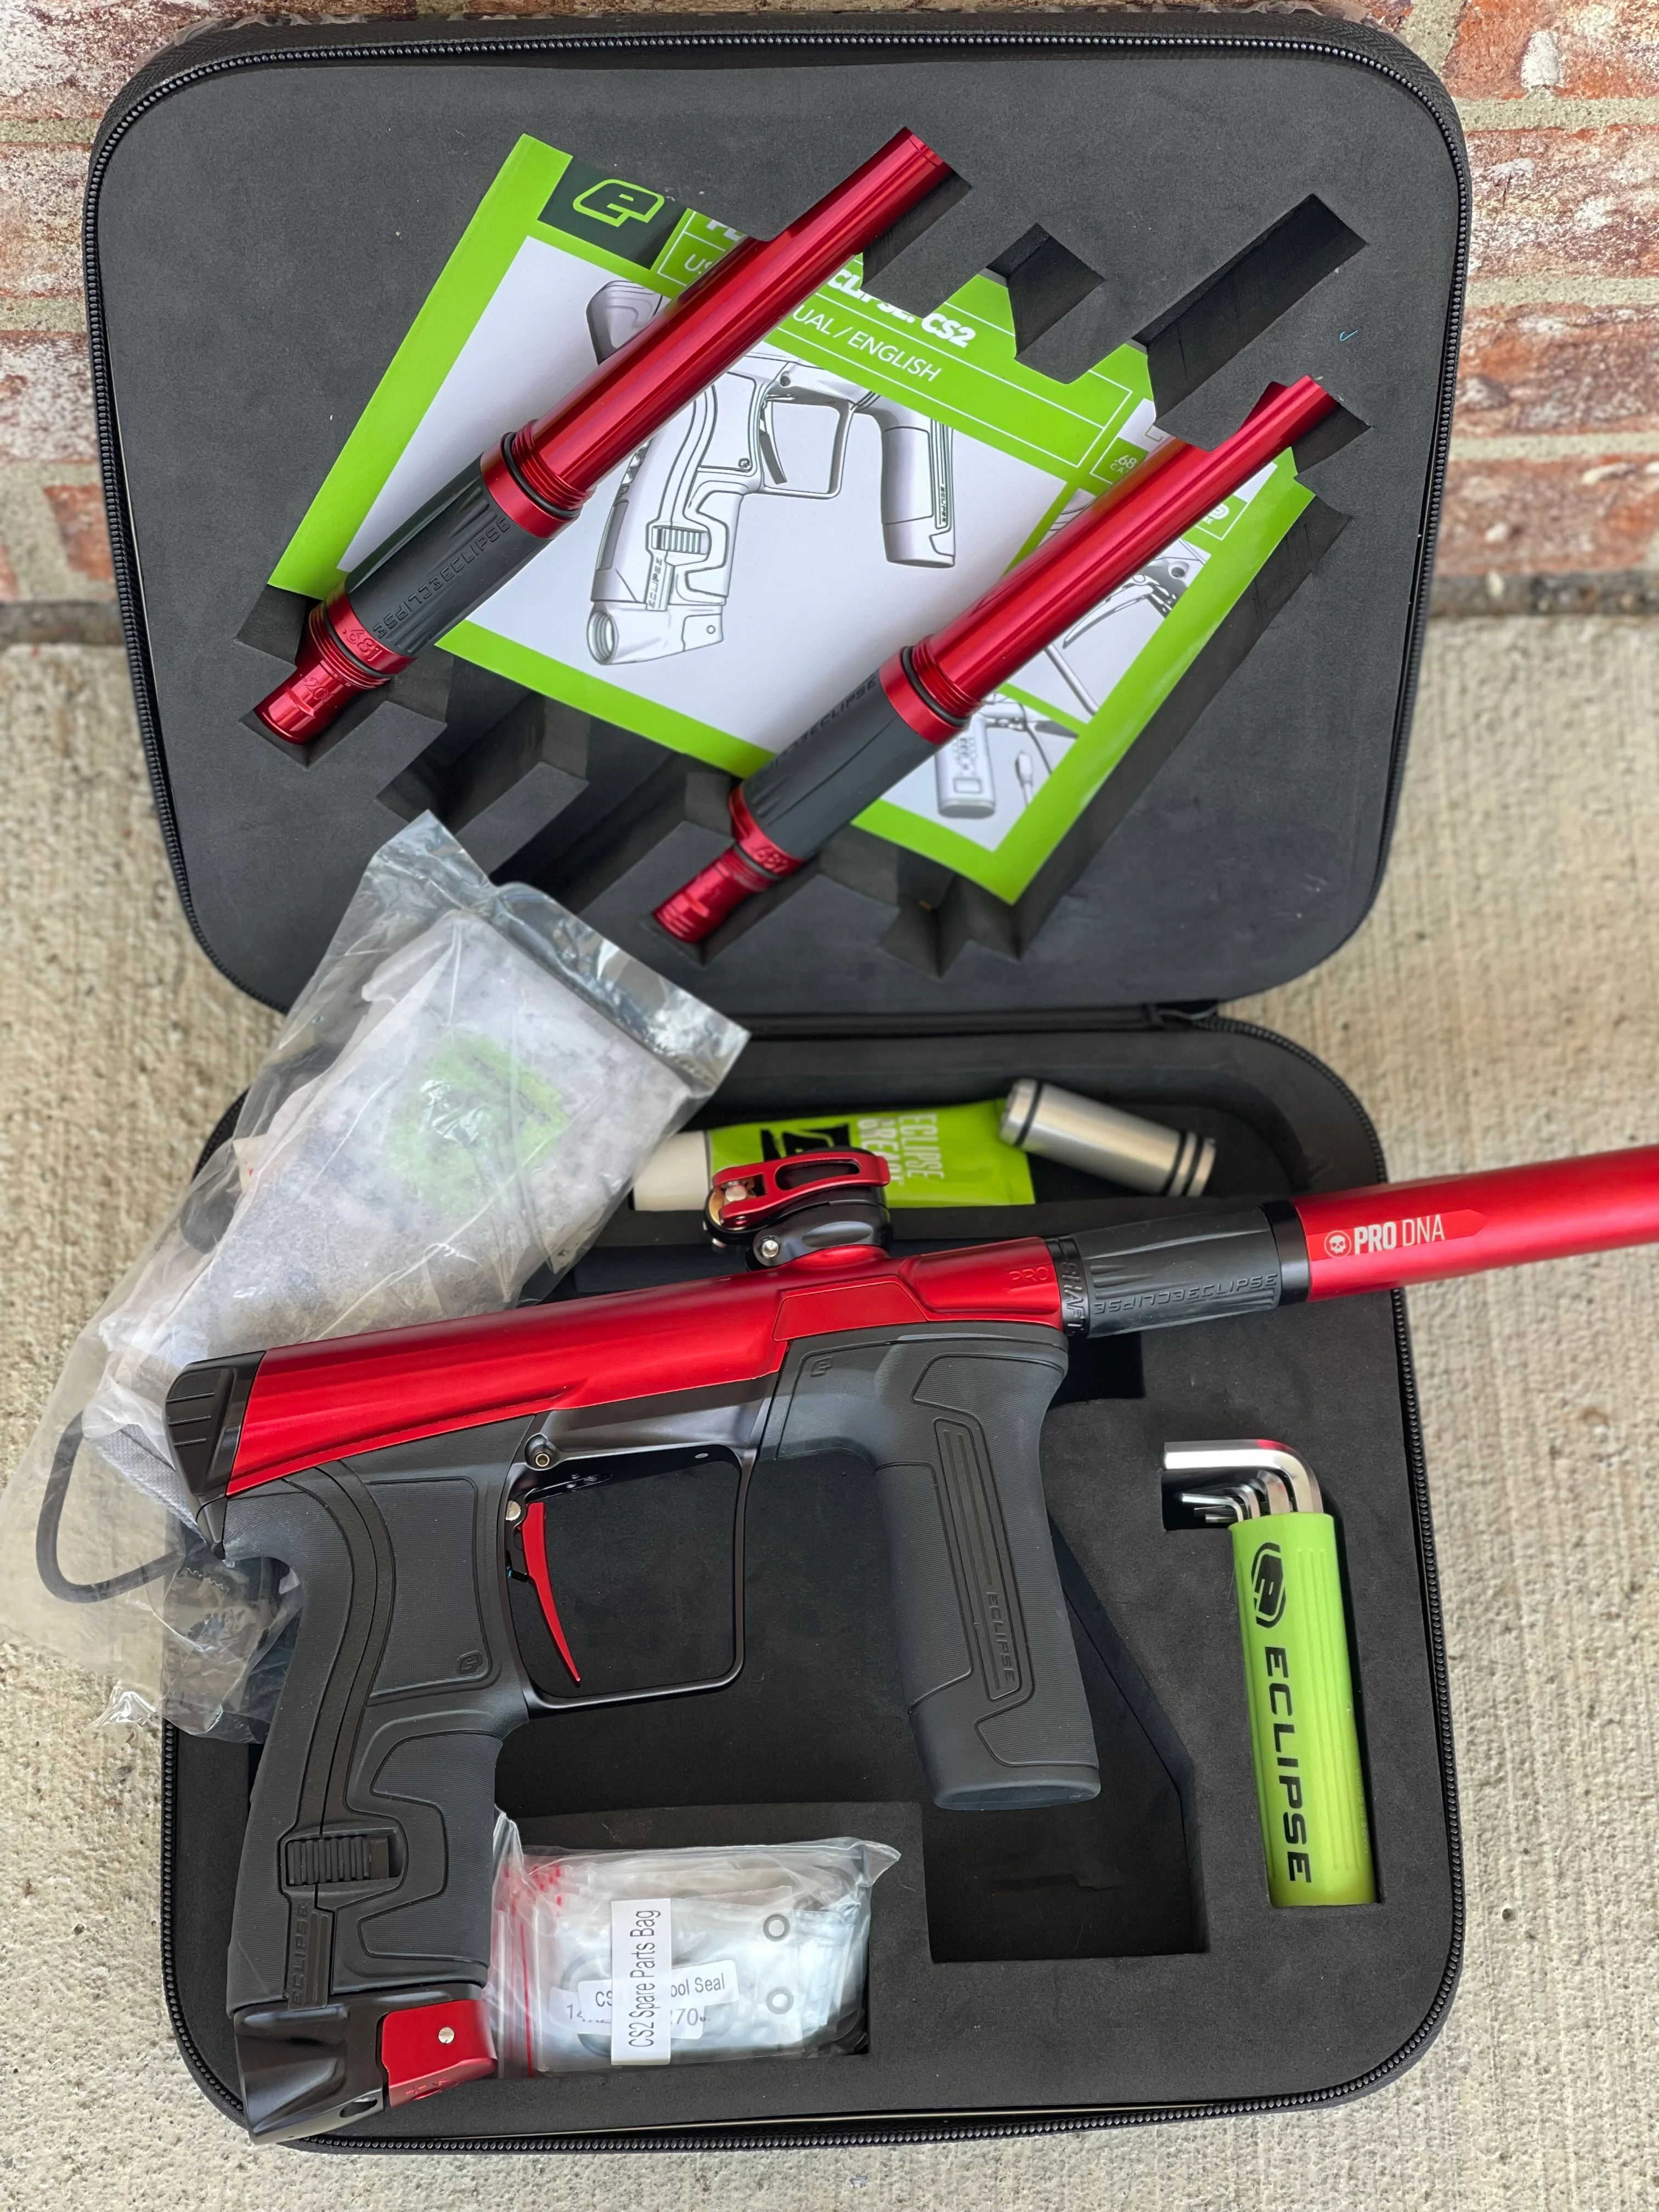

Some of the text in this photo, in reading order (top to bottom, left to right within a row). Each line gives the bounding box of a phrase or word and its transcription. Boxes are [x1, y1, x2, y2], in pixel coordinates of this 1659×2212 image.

[792, 304, 834, 335] UAL
[847, 330, 942, 382] ENGLISH
[921, 312, 976, 348] CS2
[1110, 463, 1129, 474] CA
[1114, 454, 1137, 469] .68
[898, 1112, 945, 1180] ECLIPSE
[1353, 1214, 1446, 1256] PRO DNA
[1009, 1266, 1049, 1282] PRO
[1187, 1273, 1278, 1300] ECLIPSE
[986, 1592, 1015, 1681] ECLIPSE
[1263, 1646, 1312, 1884] ECLIPSE
[291, 1900, 308, 2005] ECLIPSE
[595, 1990, 612, 2007] CS
[694, 1972, 725, 1994] Seal
[628, 1910, 661, 2047] CS2 Spare Parts Bag
